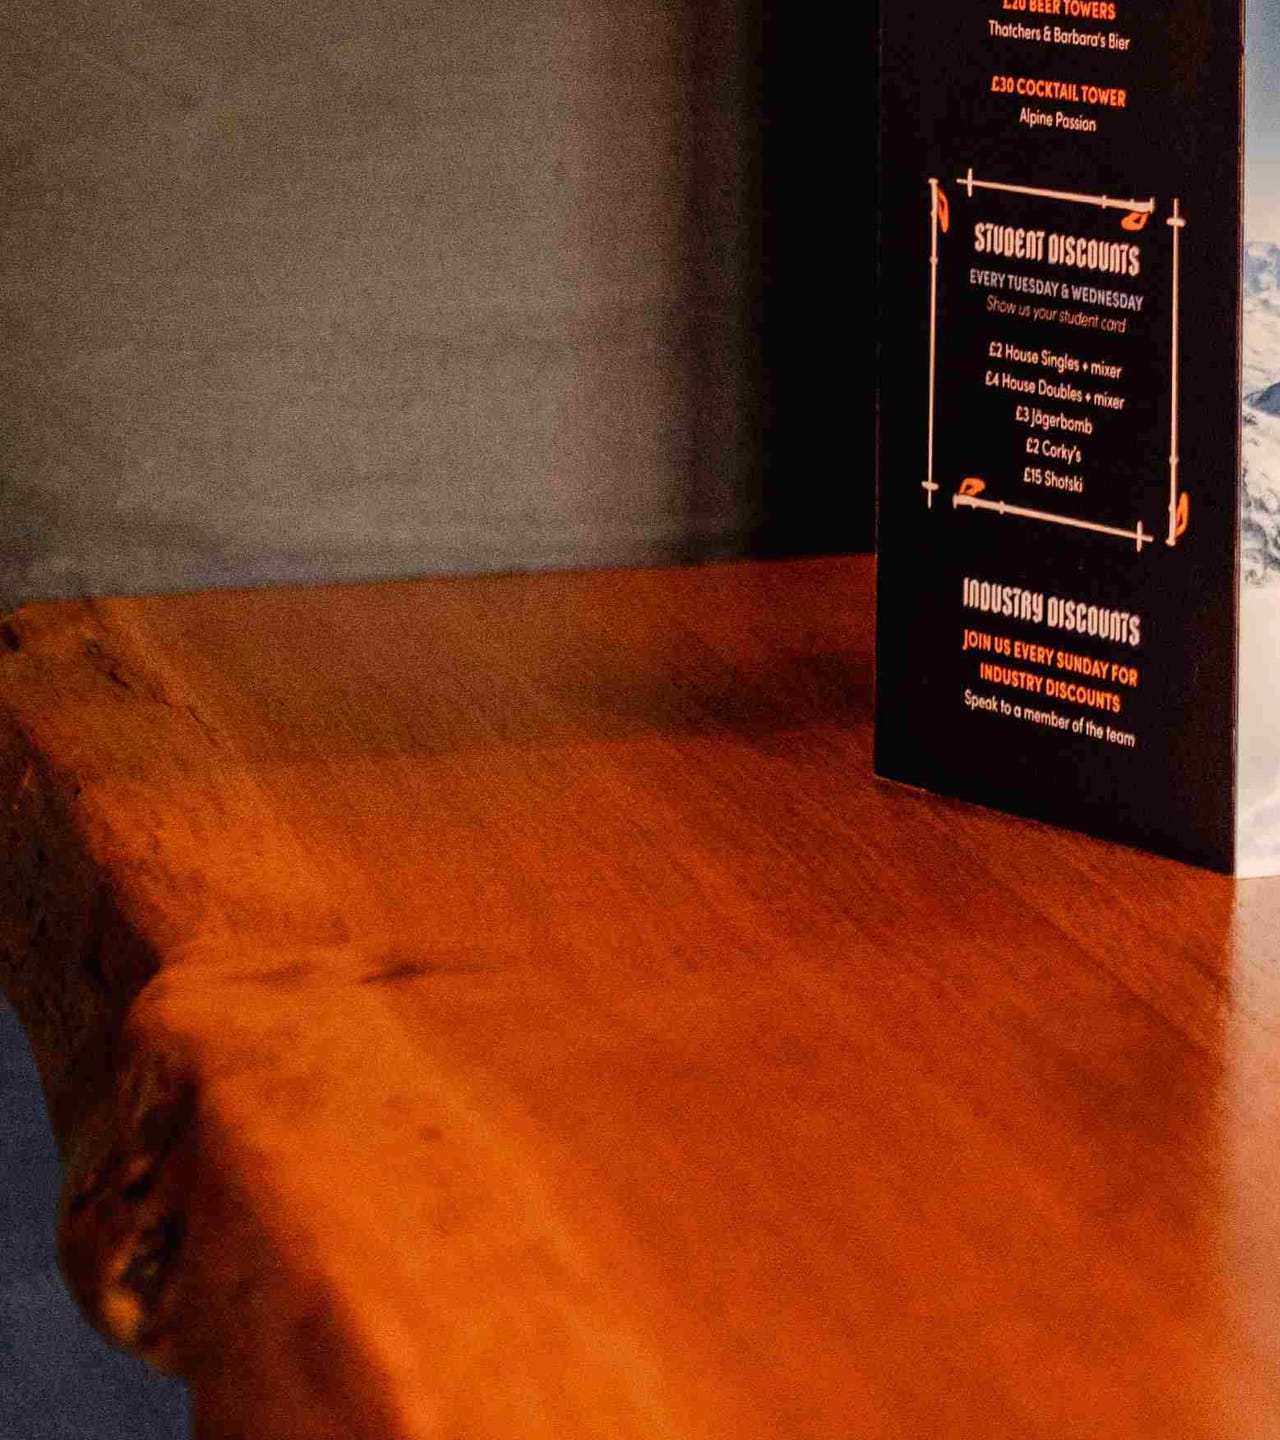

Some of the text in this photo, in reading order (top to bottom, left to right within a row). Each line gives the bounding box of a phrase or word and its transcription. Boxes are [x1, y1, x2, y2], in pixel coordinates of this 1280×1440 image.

[1063, 0, 1116, 20] TOWERS
[989, 19, 1130, 50] Thatchers & Barbara's Bier
[991, 75, 1127, 108] £30 COCKTAIL TOWER
[1020, 107, 1097, 132] Alpine Passion
[974, 222, 1140, 276] STUDENT DISCOUNTS
[970, 268, 1144, 312] EVERY TUESDAY & WEDNESDAY
[986, 294, 1127, 333] Show us your student card
[989, 341, 1003, 358] £2
[1005, 343, 1039, 364] House
[1041, 349, 1081, 373] Singles
[1091, 360, 1123, 379] mixer
[985, 370, 1000, 387] £4
[1002, 372, 1036, 394] House
[1038, 378, 1082, 402] Doubles
[1093, 391, 1125, 410] mixer
[1016, 405, 1030, 422] £3
[1026, 437, 1082, 464] £2 Corky's
[1024, 467, 1084, 493] £15 Shotski
[963, 577, 1140, 646] INDUSTRY DISCOUNTS
[962, 629, 1138, 688] JOIN US EVERY SUNDAY FOR
[980, 662, 1121, 713] INDUSTRY DISCOUNTS
[964, 689, 1136, 748] Speak to a member of the team
